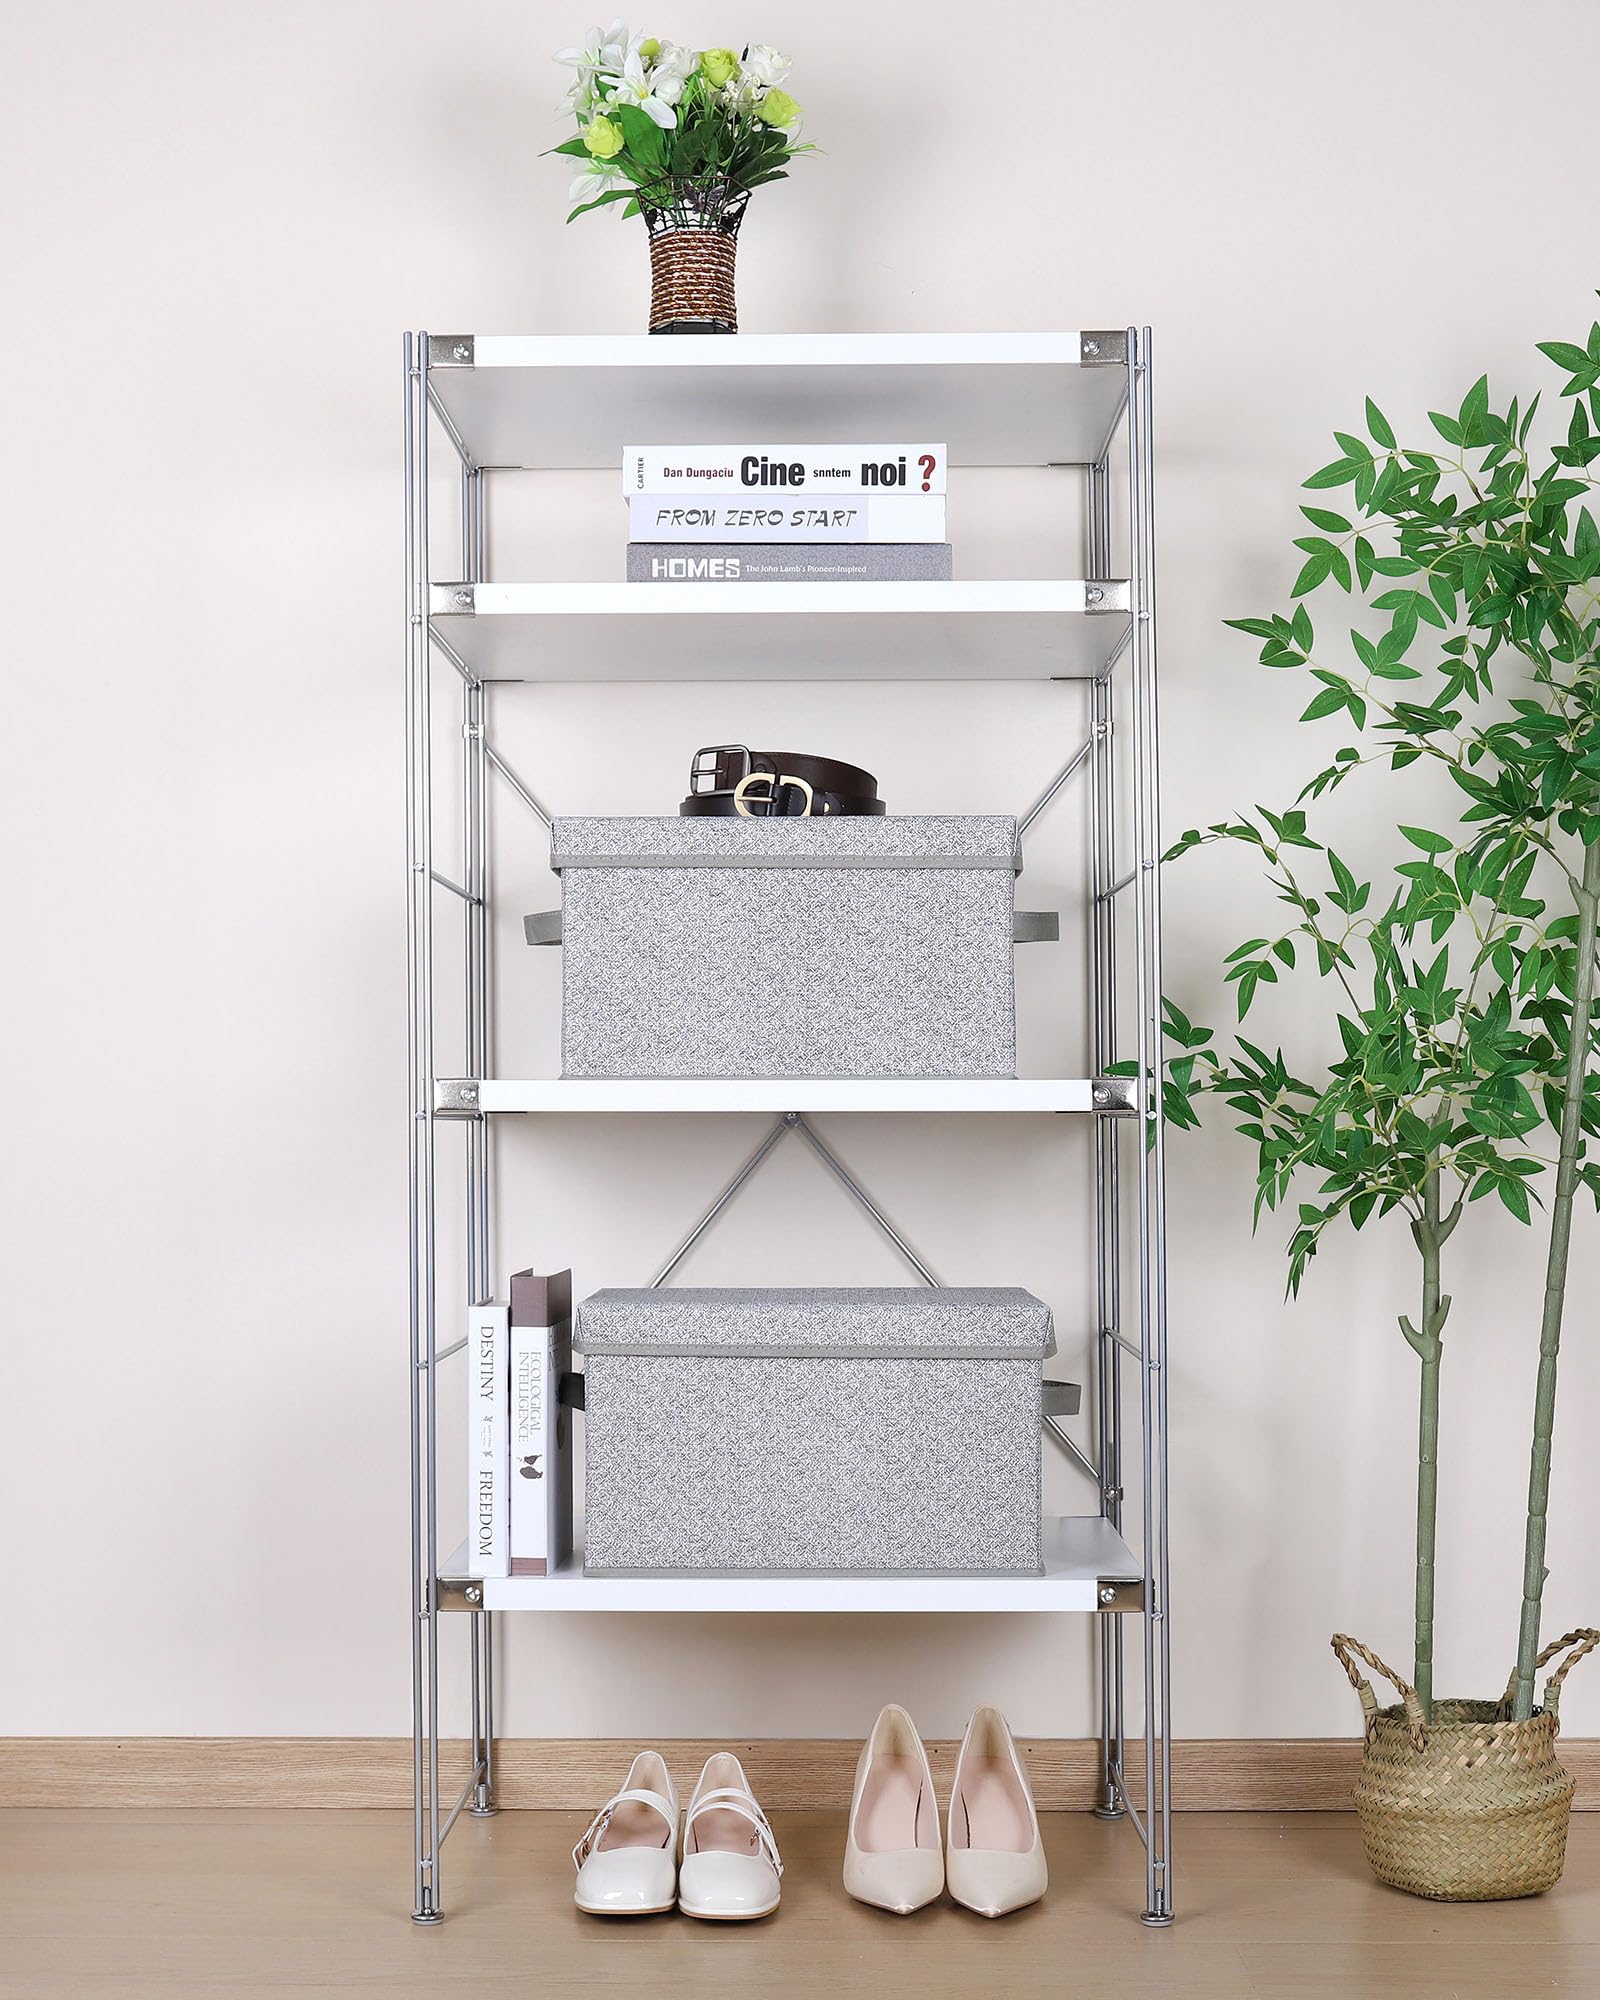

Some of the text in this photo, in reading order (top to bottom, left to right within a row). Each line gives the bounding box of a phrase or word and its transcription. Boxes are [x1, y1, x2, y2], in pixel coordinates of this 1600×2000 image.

[637, 457, 645, 489] CARTIER
[663, 466, 734, 481] Dan Dungaciu
[740, 454, 937, 492] Cine snntem noi ?
[656, 509, 857, 528] FROM ZERO START
[652, 558, 740, 578] HOMES
[745, 565, 759, 573] The
[761, 565, 778, 573] John
[780, 565, 806, 573] Lamb's
[480, 1326, 494, 1401] DESTINY
[517, 1351, 529, 1442] INTELLIGENCE
[479, 1471, 494, 1556] FREEDOM
